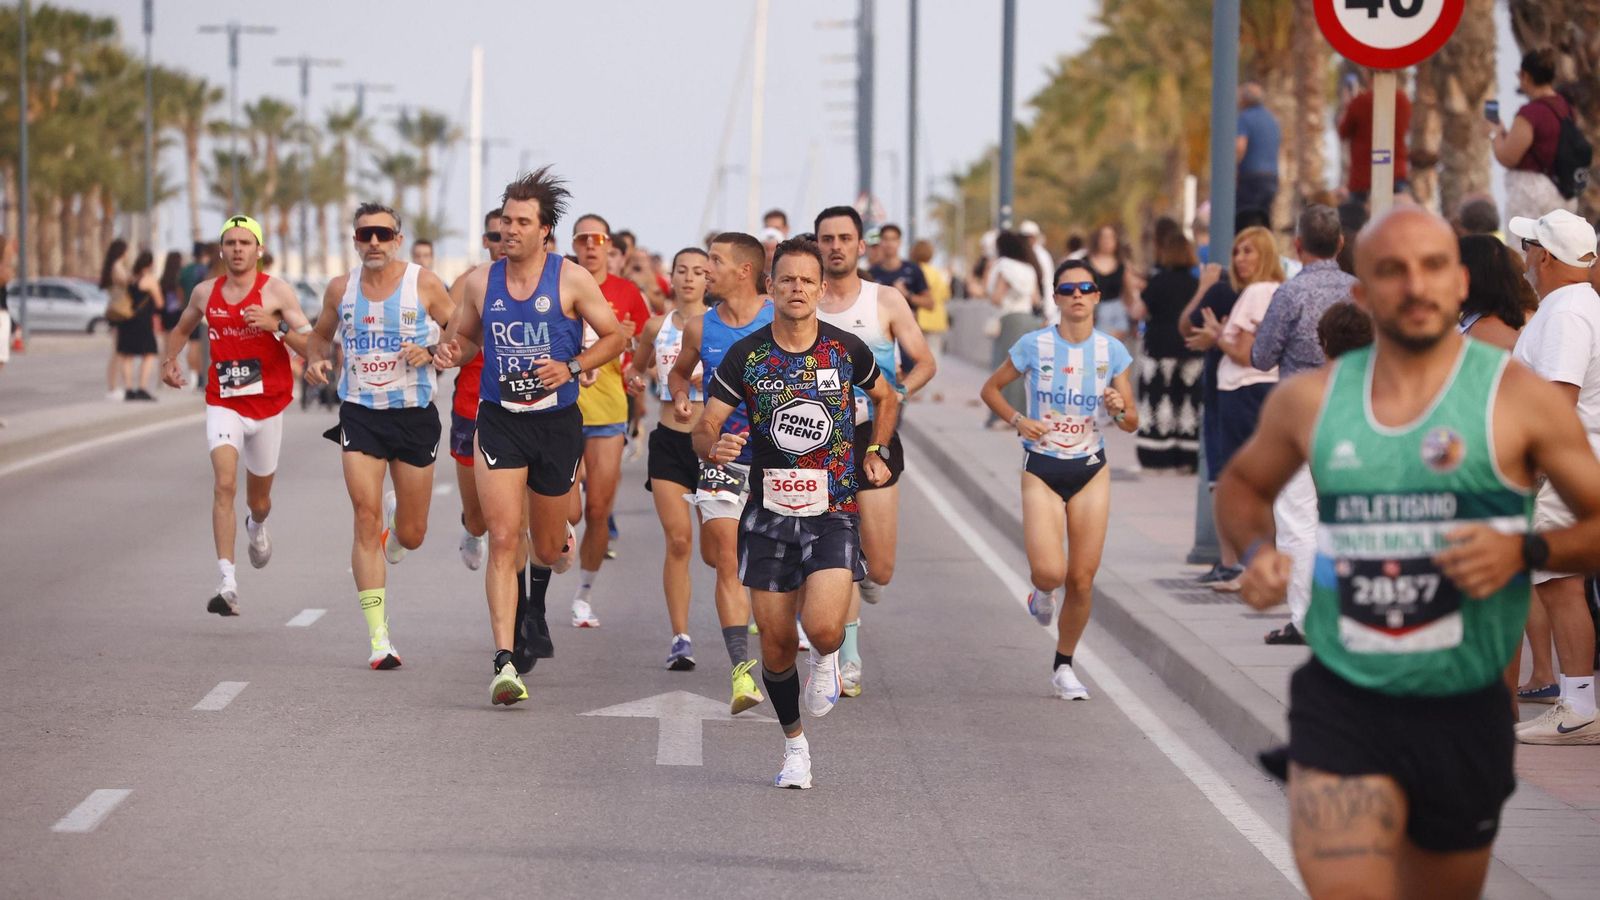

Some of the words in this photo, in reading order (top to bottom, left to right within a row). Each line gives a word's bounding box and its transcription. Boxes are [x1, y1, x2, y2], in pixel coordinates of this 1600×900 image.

[491, 321, 550, 346] RCM
[361, 361, 397, 373] 3097
[661, 355, 677, 365] 37
[509, 377, 544, 392] 1332
[818, 379, 837, 390] AXA
[780, 413, 825, 431] PONLE
[1052, 422, 1085, 434] 3201
[778, 423, 822, 441] FRENO
[704, 468, 734, 484] 1037
[771, 479, 818, 492] 3668
[1336, 493, 1458, 521] ATLETISMO
[1351, 574, 1440, 606] 2857
